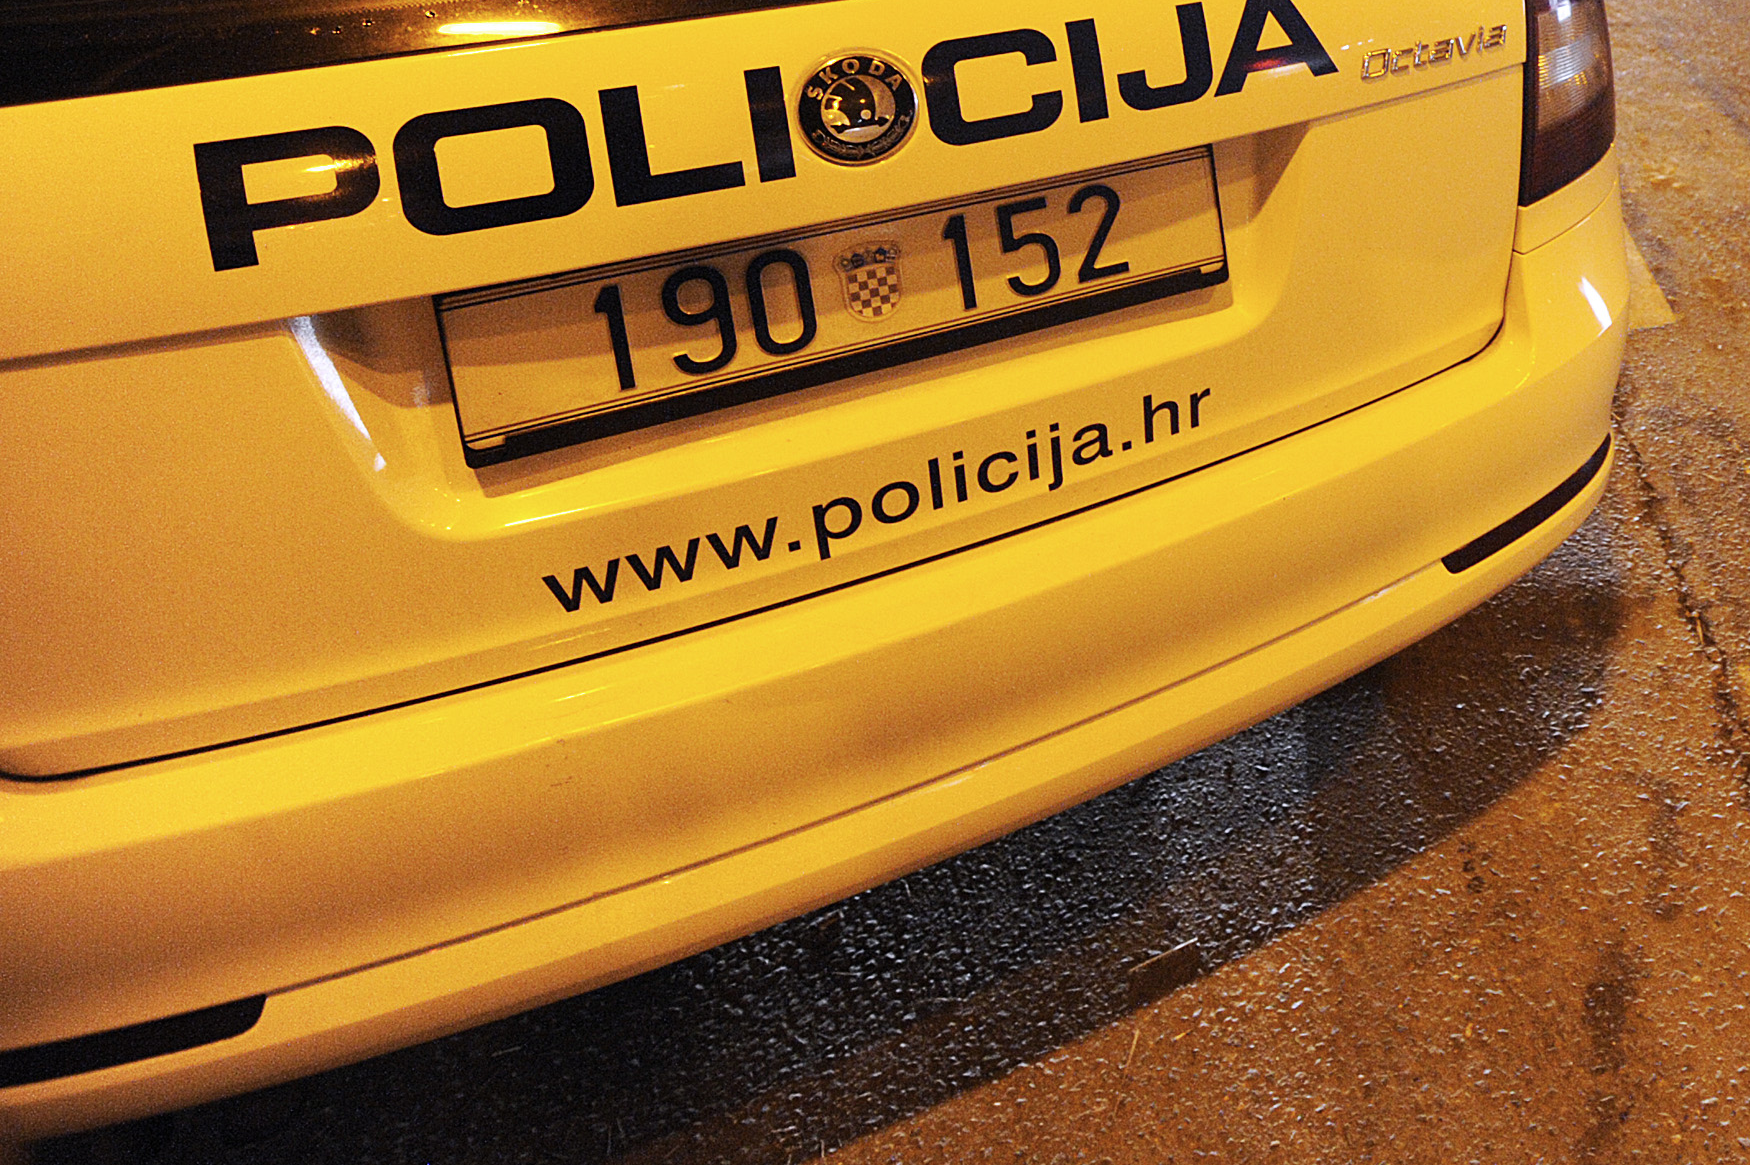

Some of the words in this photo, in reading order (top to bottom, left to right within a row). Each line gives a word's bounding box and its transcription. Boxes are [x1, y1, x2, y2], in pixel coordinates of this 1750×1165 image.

[1361, 24, 1507, 80] Octavia
[593, 248, 819, 391] 190
[940, 183, 1130, 311] 152
[542, 388, 1211, 612] www.policija.hr
